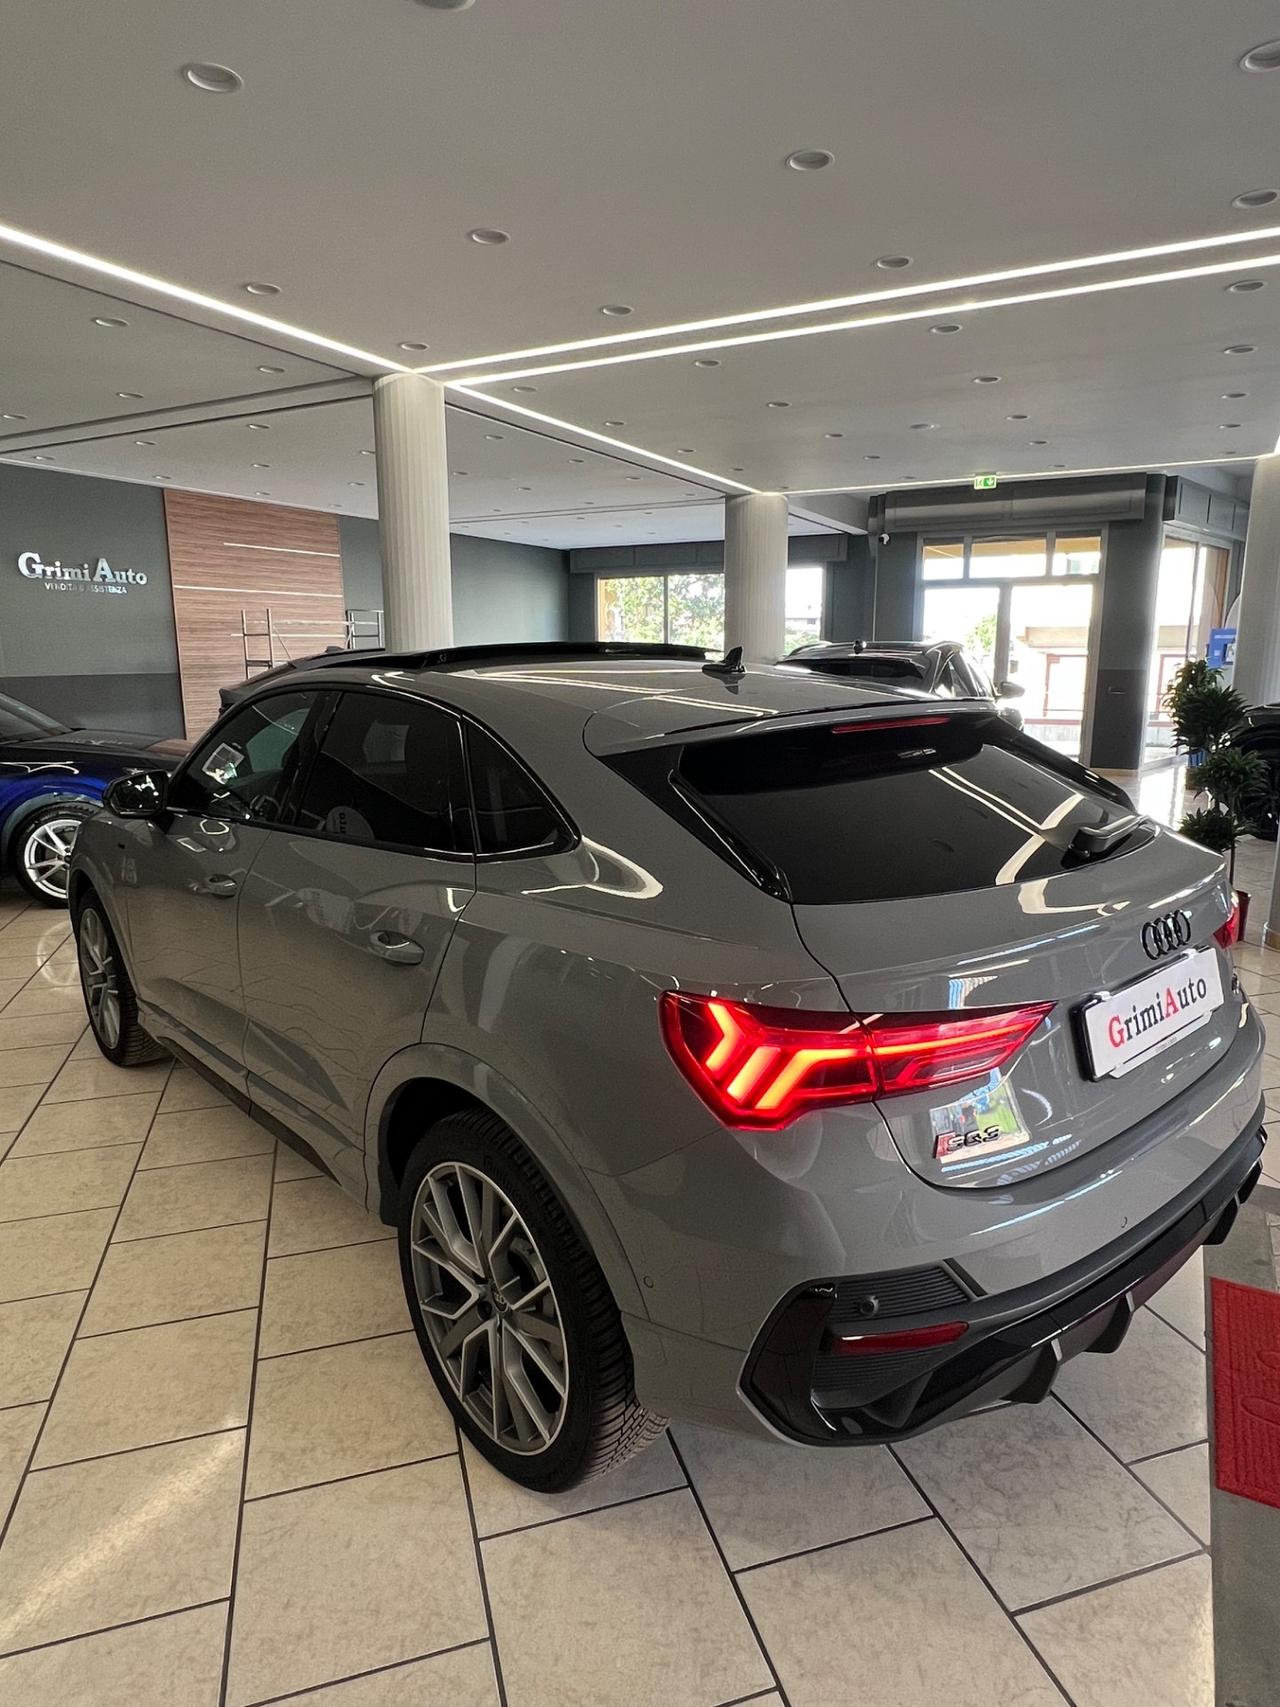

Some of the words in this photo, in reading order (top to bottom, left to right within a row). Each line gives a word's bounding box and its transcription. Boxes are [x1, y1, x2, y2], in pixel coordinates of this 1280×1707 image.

[18, 551, 91, 581] Grimi
[93, 557, 148, 585] Auto
[1108, 977, 1207, 1048] GrimiAuto
